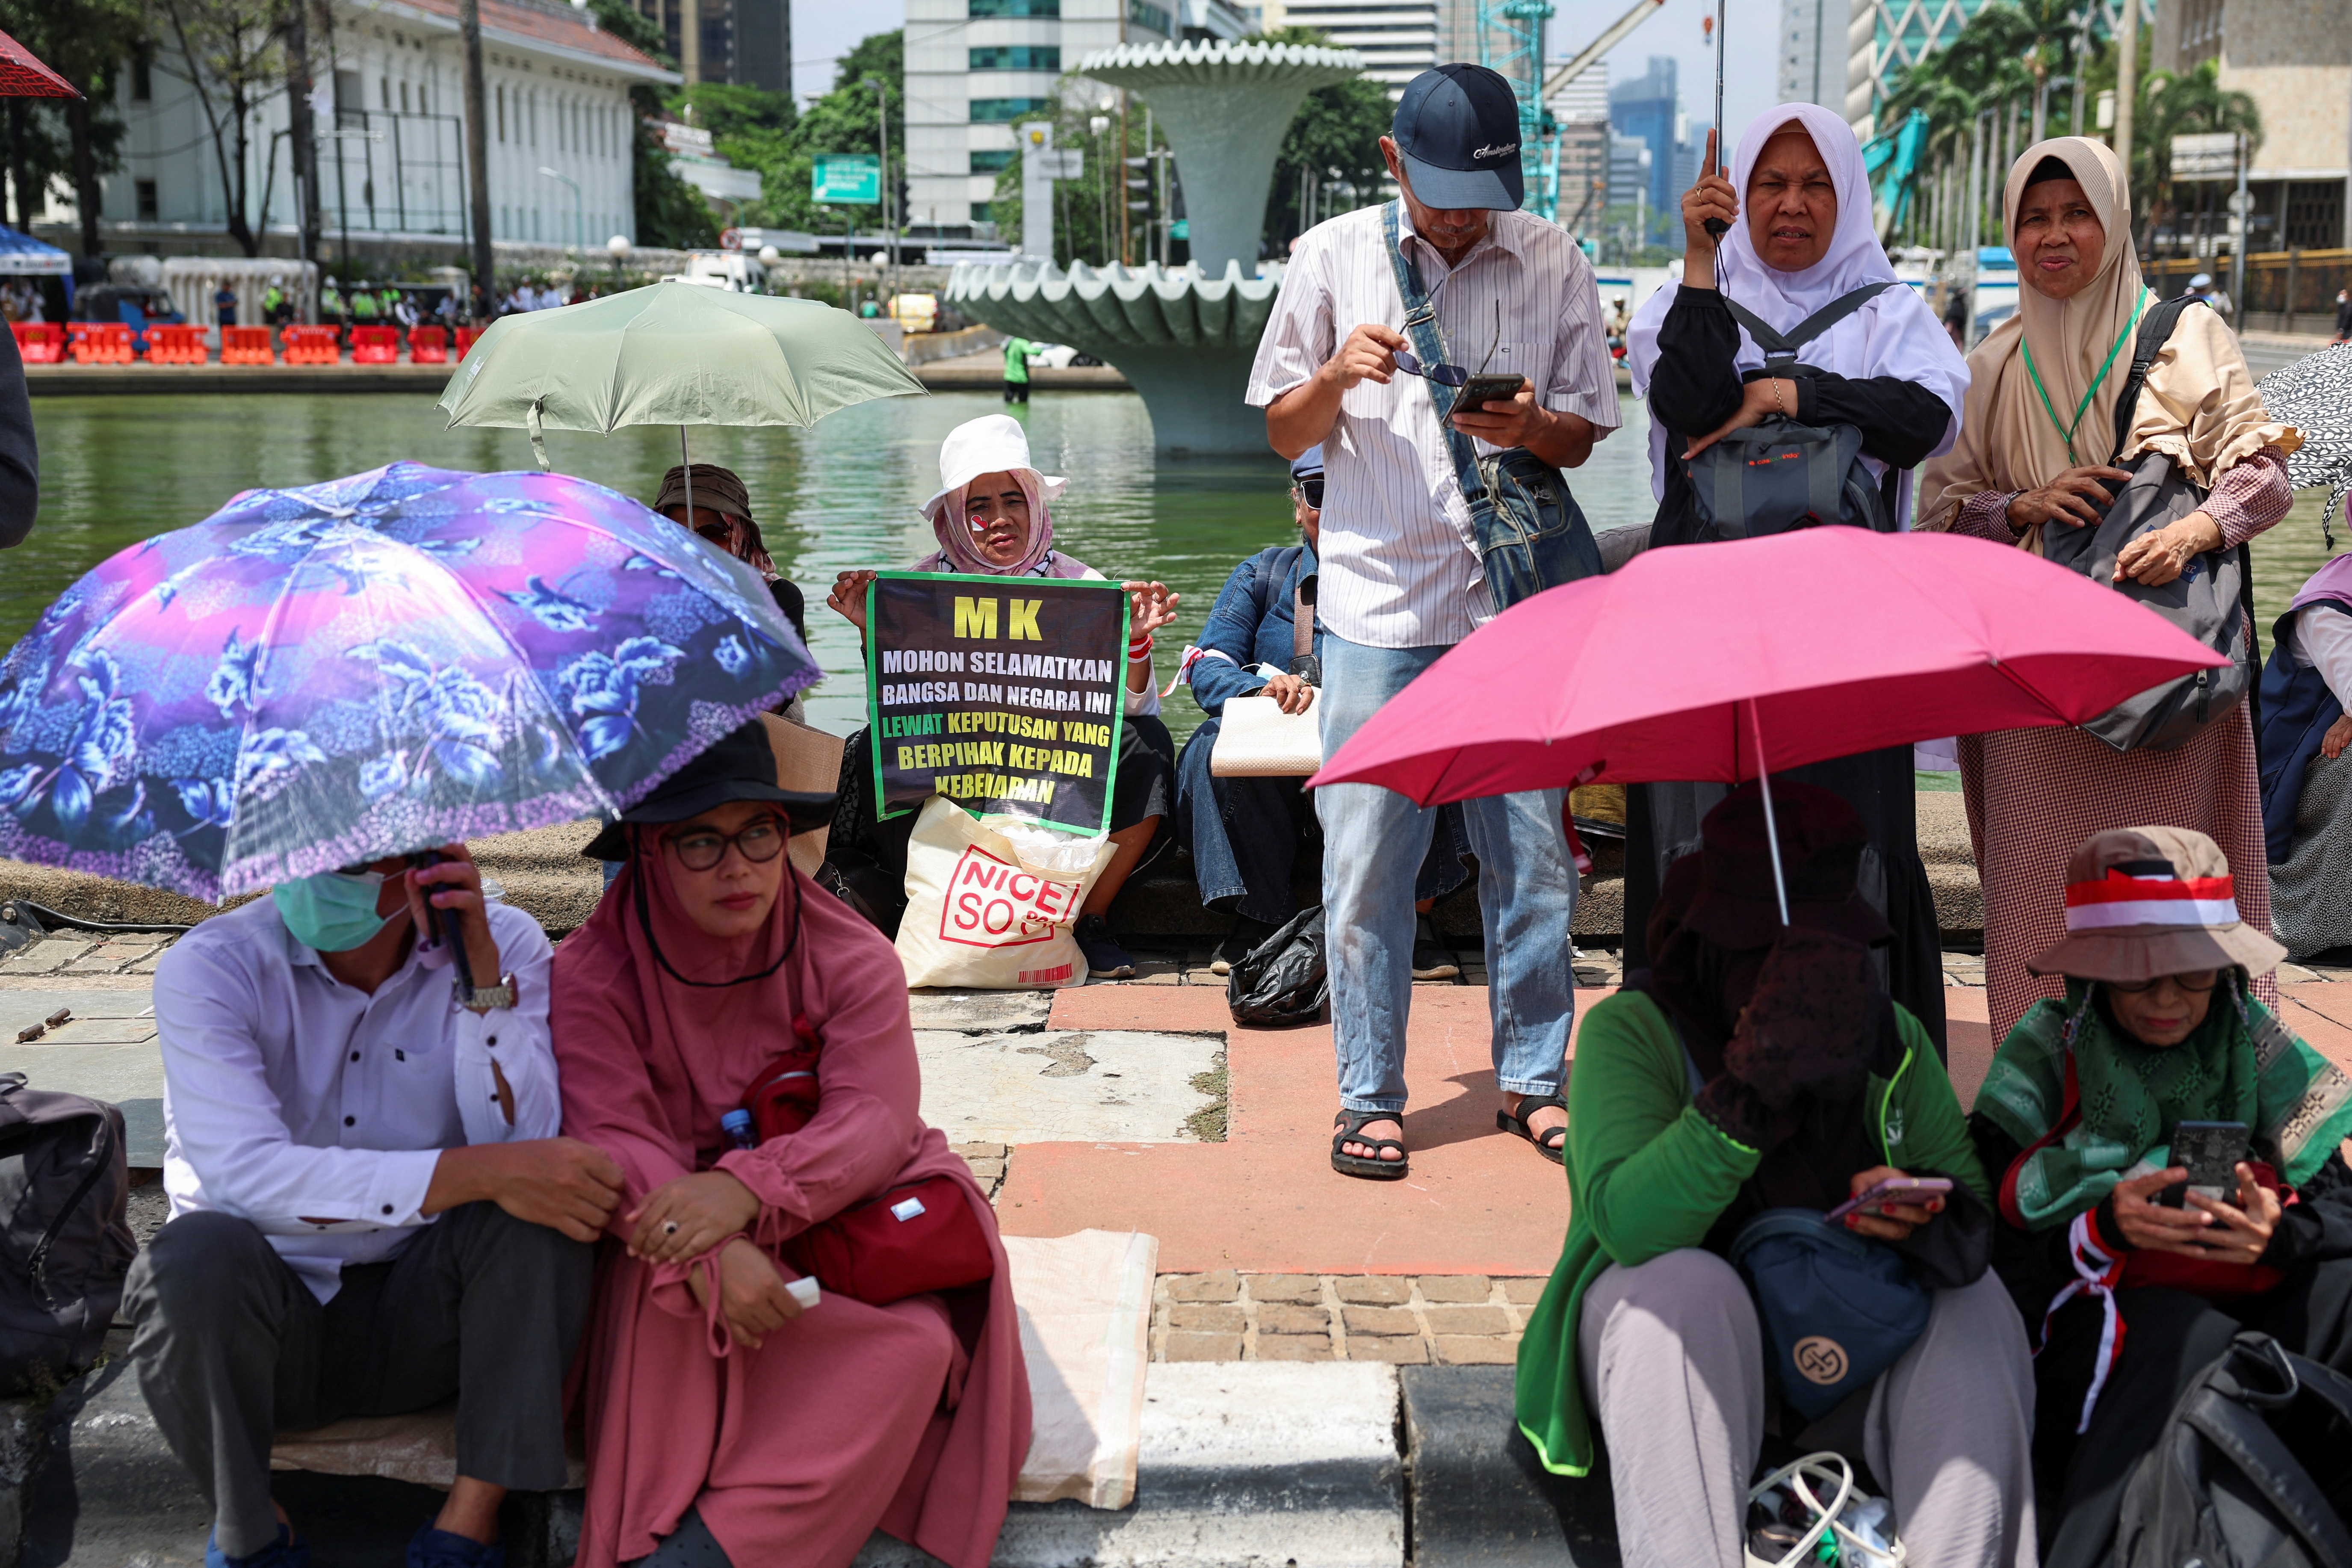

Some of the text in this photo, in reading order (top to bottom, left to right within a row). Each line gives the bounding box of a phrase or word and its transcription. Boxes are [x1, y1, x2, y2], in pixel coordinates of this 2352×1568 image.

[1473, 143, 1516, 159] Amsterdam
[883, 650, 1112, 683] MOHON SELAMATKAN
[883, 682, 1111, 715] BANGSA DAN NEGARA INI
[882, 712, 1110, 747] LEWAT KEPUTUSAN YANG
[898, 741, 1092, 778] BERPIHAK KEPADA
[962, 861, 1068, 915] NICE
[954, 892, 1014, 935] SO
